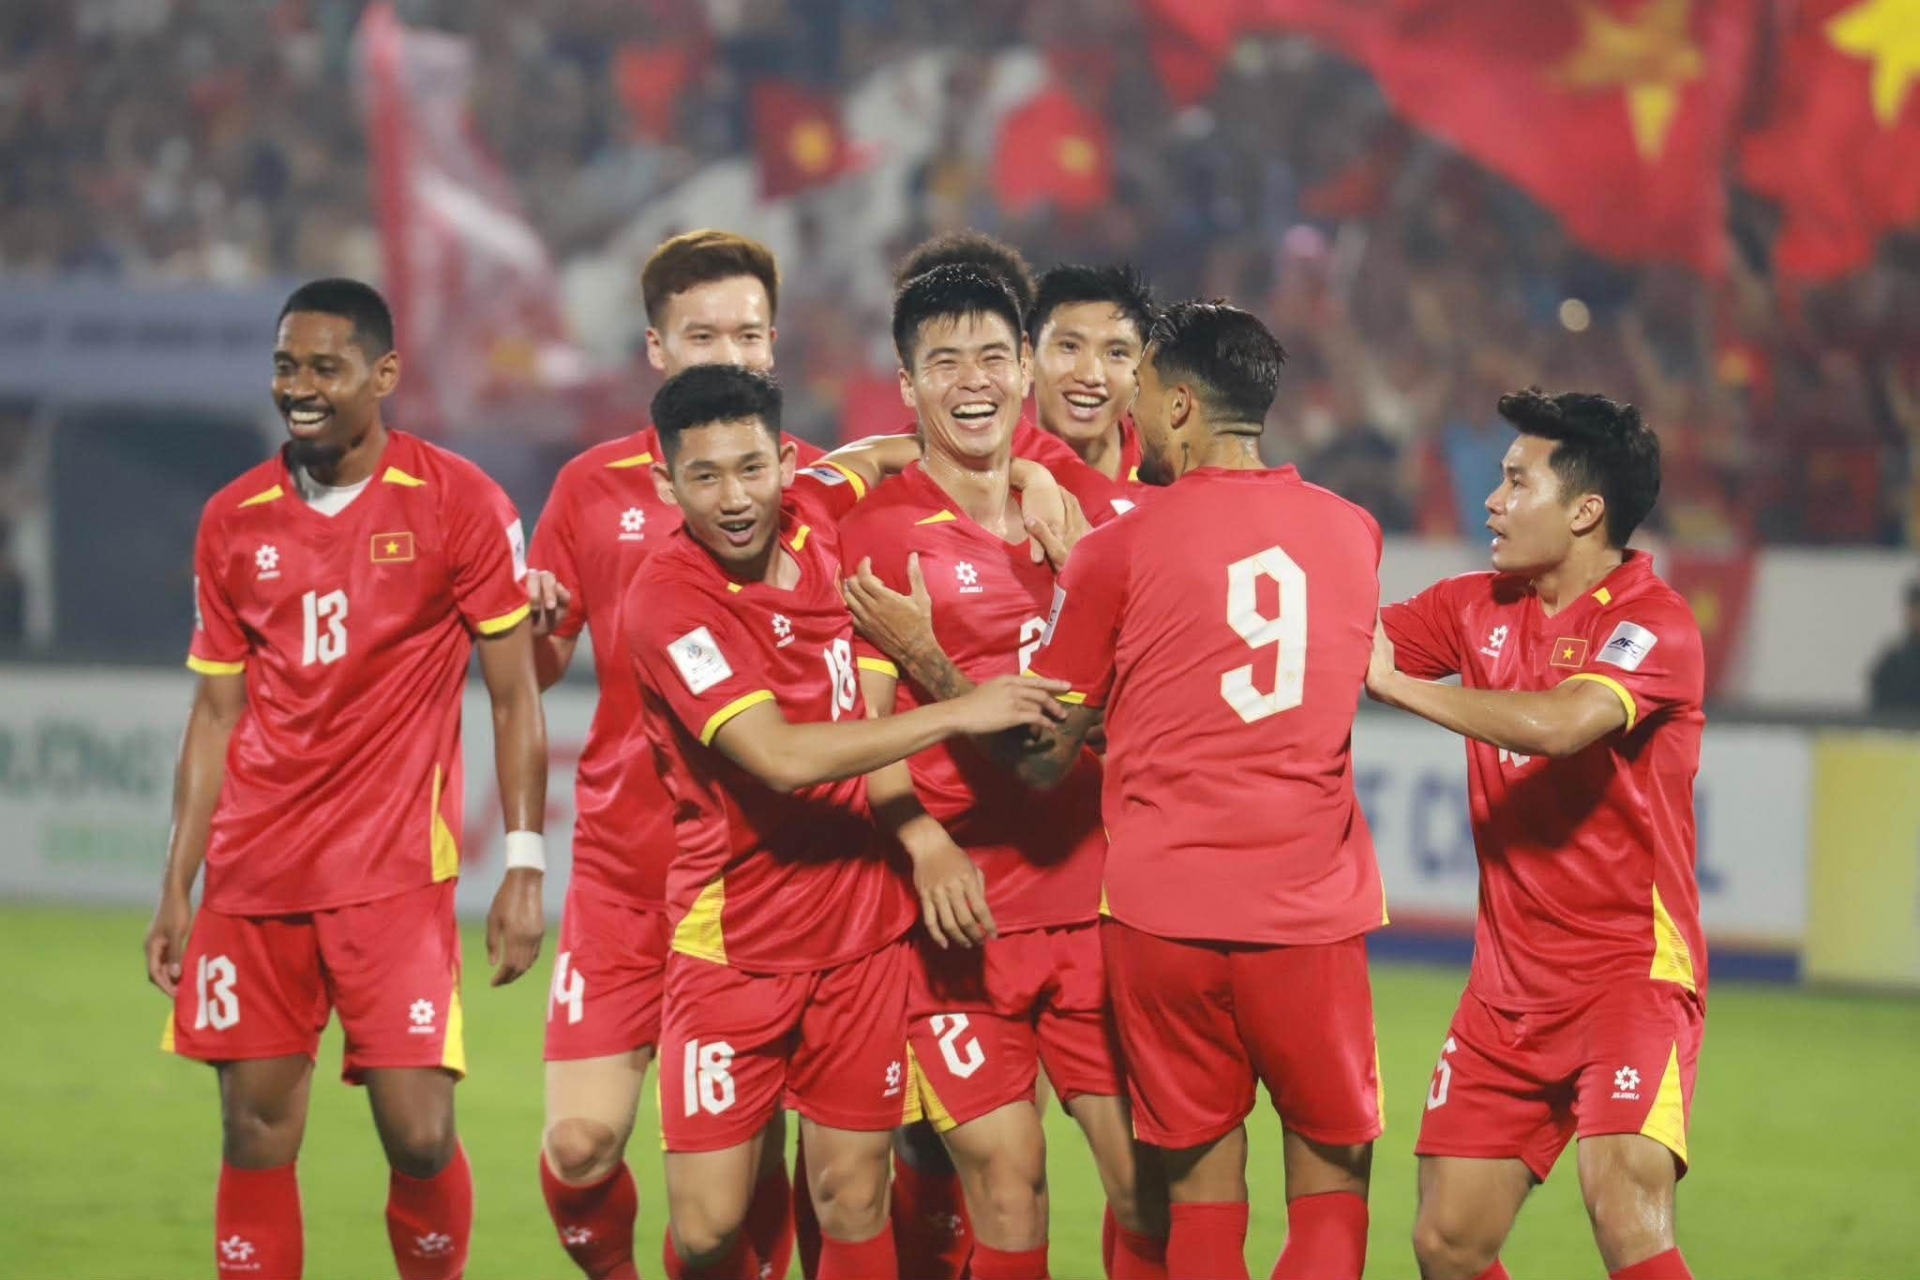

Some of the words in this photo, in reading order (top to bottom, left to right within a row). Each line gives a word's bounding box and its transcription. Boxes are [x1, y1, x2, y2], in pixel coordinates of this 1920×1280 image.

[302, 588, 348, 667] 13
[1221, 546, 1307, 723] 9
[823, 637, 857, 721] 18
[194, 954, 240, 1031] 13
[683, 1038, 736, 1117] 18
[929, 1012, 986, 1079] 2
